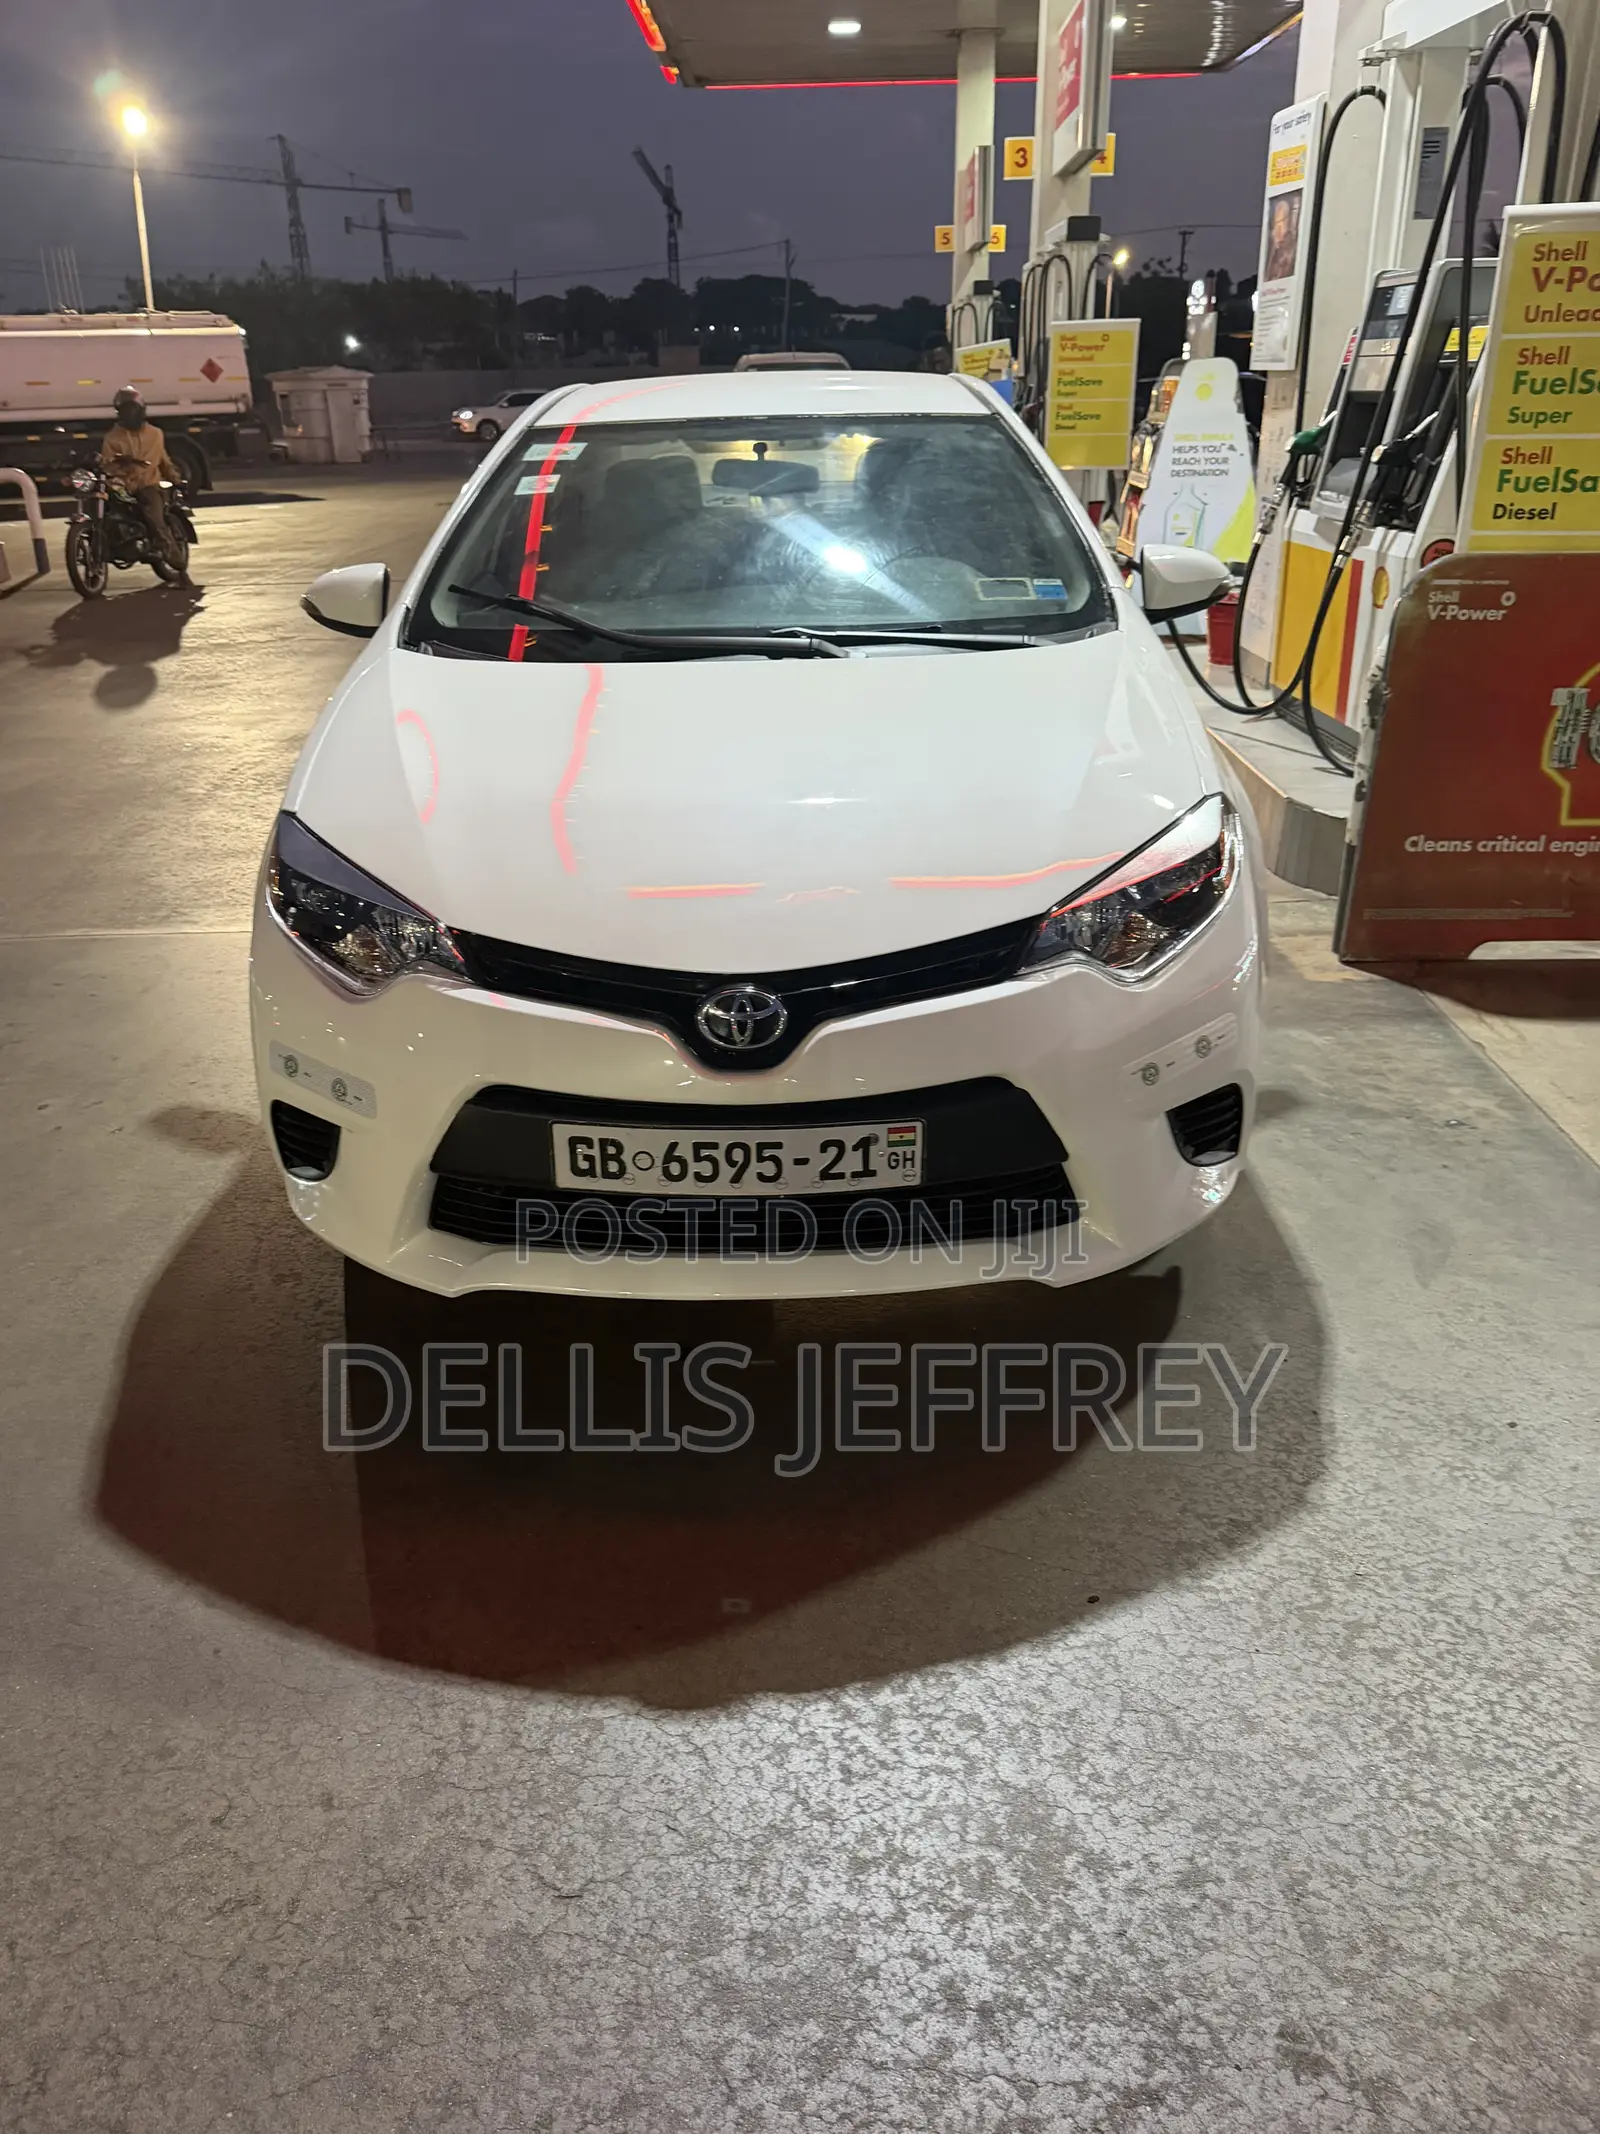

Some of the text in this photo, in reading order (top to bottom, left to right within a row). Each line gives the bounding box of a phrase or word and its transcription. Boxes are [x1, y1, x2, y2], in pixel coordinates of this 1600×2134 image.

[1014, 147, 1028, 168] 3
[942, 232, 950, 245] 5
[1532, 240, 1588, 262] Shell
[1517, 345, 1571, 365] Shell
[1512, 367, 1600, 395] FuelS
[1507, 406, 1573, 429] Super
[1172, 445, 1222, 454] HELPS YOU
[1501, 446, 1553, 465] Shell
[1172, 457, 1229, 466] REACH YOUR
[1170, 468, 1229, 477] DESTINATION
[1496, 467, 1600, 493] FuelSa
[1492, 502, 1558, 520] Diesel
[1428, 590, 1461, 603] Shell
[1427, 604, 1508, 621] V-Power
[1404, 835, 1473, 852] Cleans
[1476, 834, 1547, 852] critical
[568, 1135, 627, 1180] GB
[887, 1150, 916, 1170] GH
